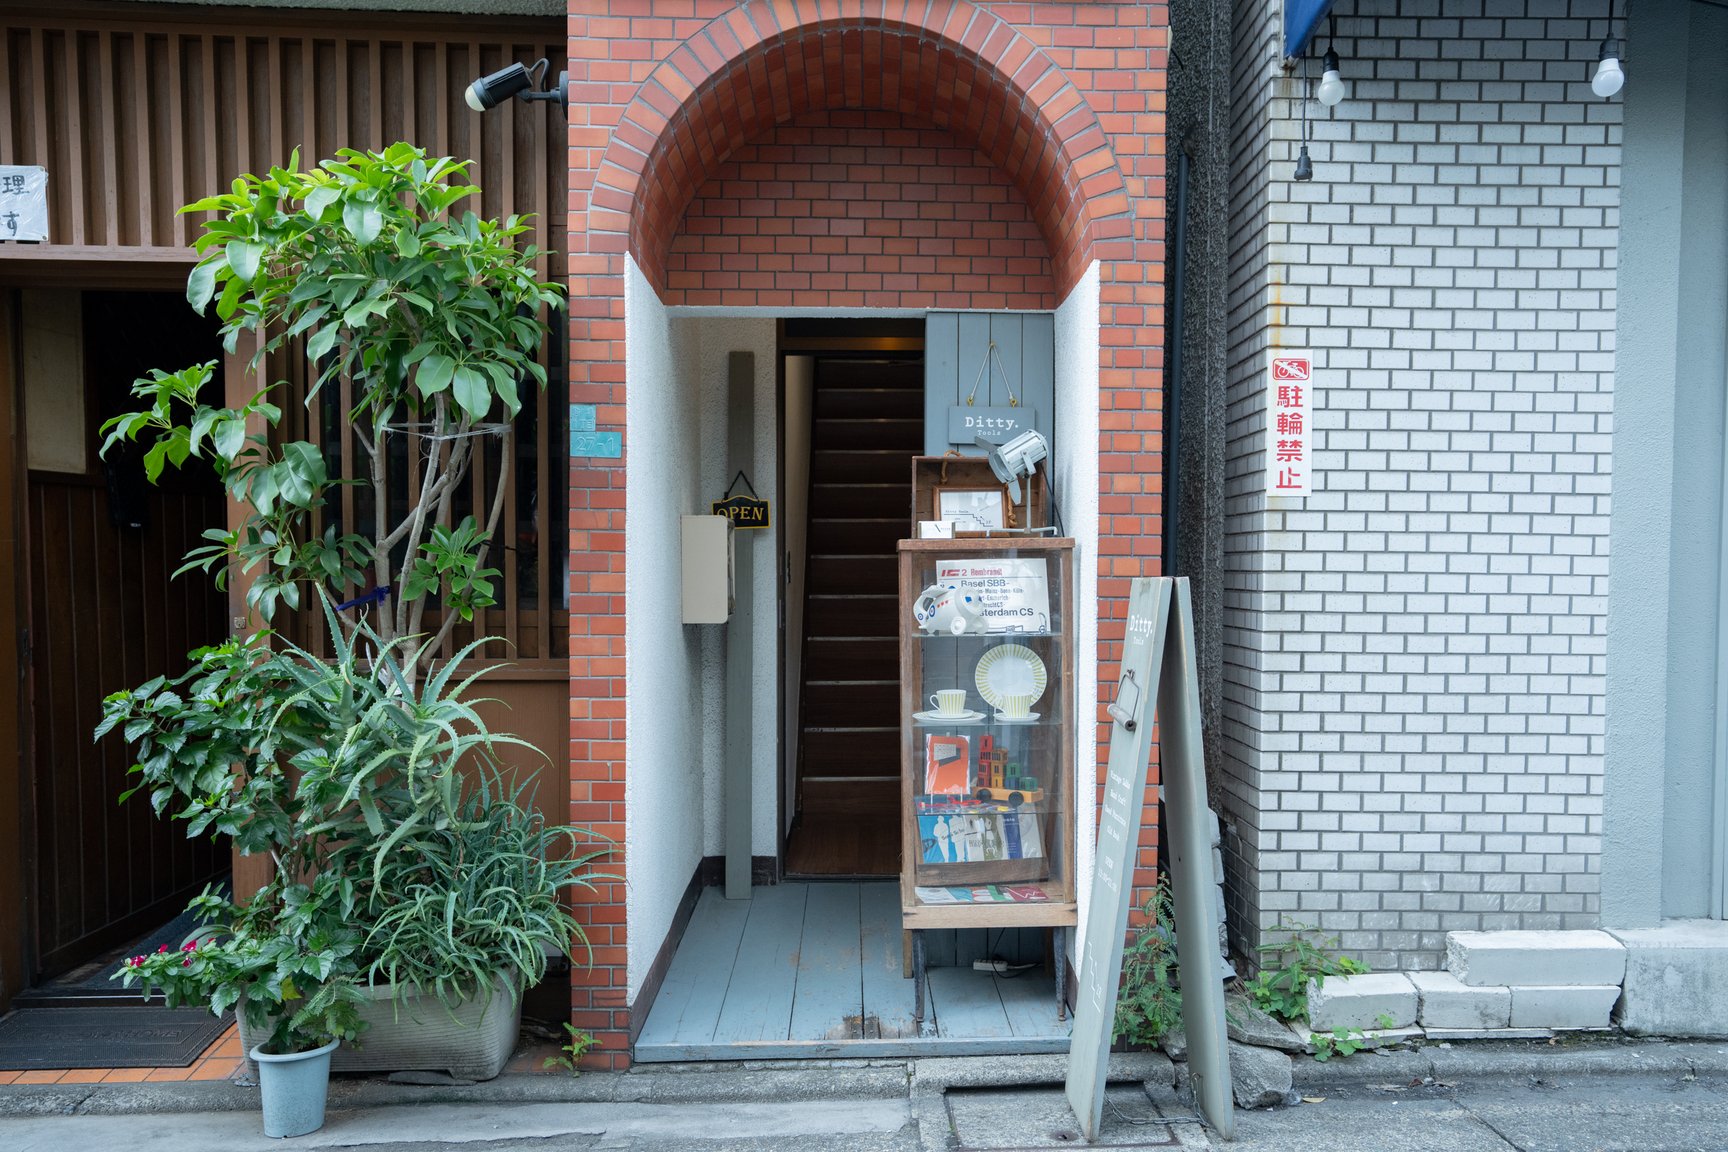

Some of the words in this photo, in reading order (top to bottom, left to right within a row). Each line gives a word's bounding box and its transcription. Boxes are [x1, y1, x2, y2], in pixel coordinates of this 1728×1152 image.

[965, 416, 1019, 430] Ditty.
[1276, 385, 1303, 489] 駐輪禁止
[576, 436, 614, 453] 27-1
[962, 569, 968, 577] 2
[980, 608, 1018, 617] sterdam
[1019, 608, 1034, 616] CS
